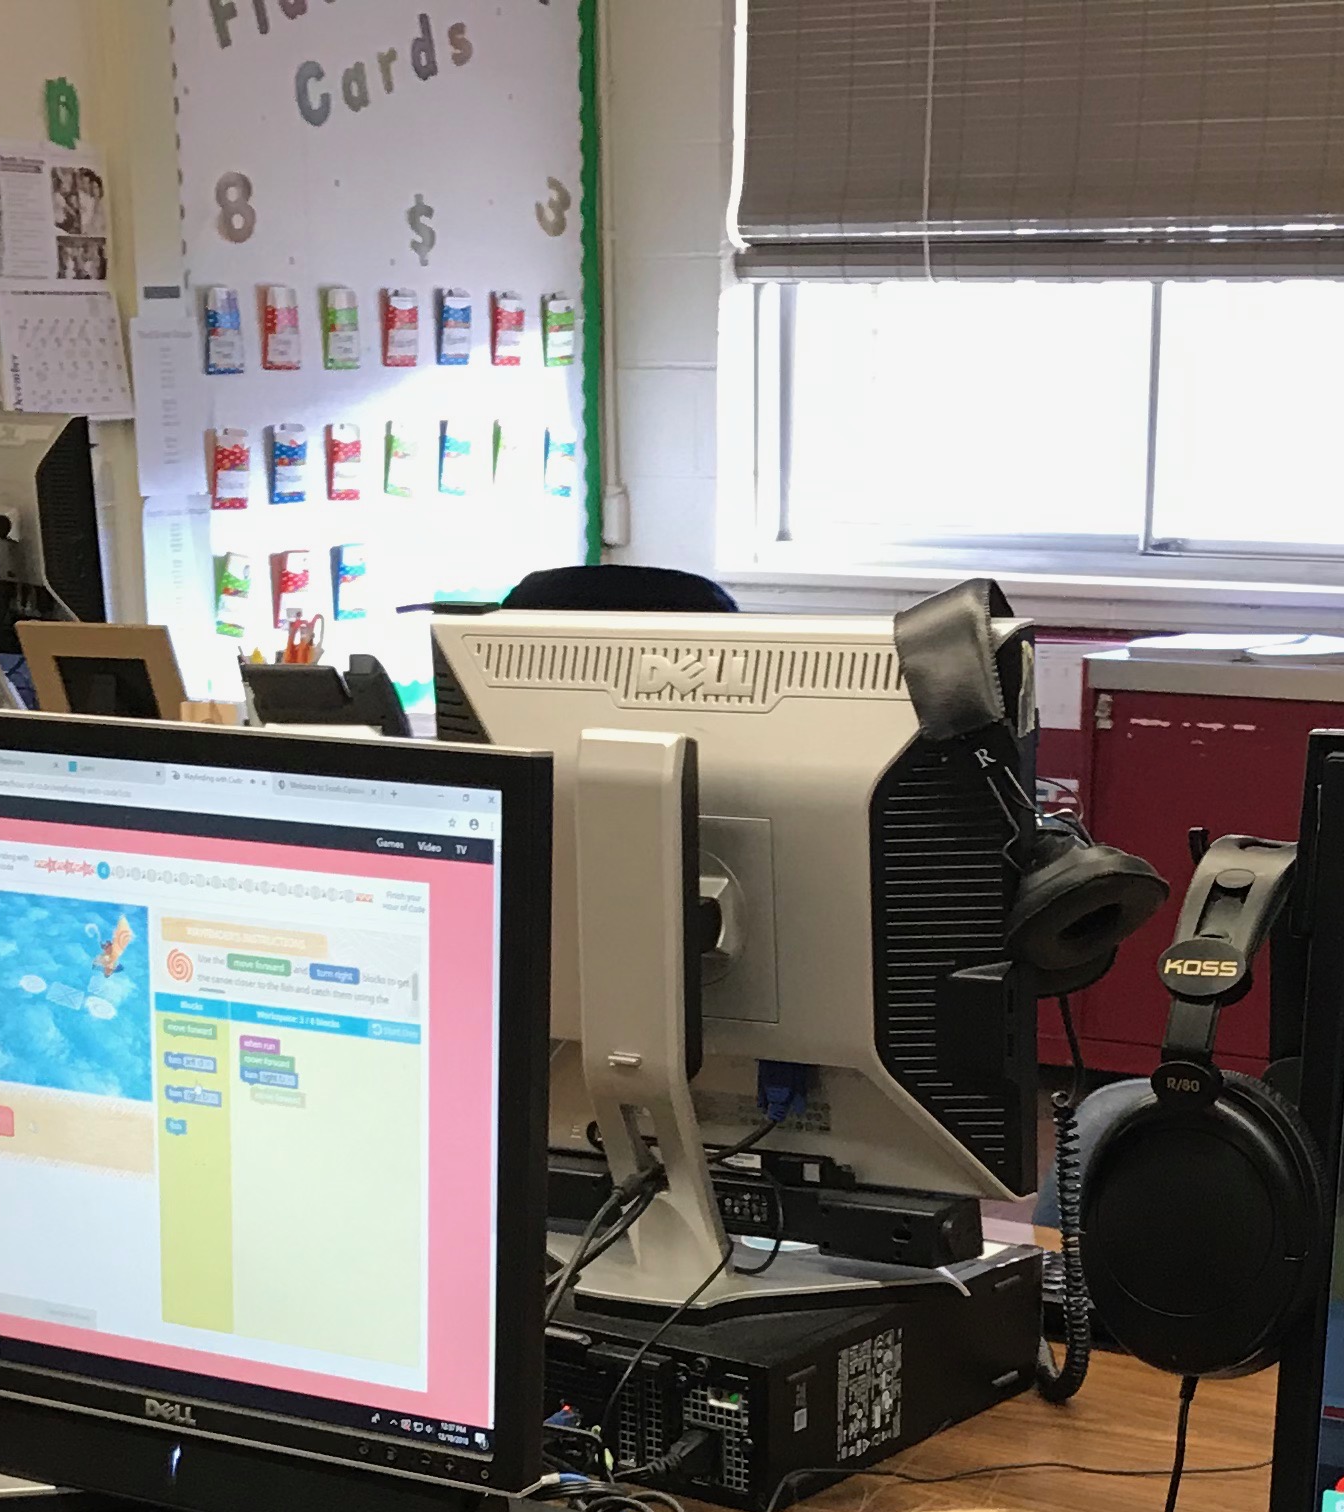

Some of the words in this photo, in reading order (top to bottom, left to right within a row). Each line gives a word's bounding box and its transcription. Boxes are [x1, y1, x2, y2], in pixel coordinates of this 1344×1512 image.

[295, 12, 474, 127] Cards
[215, 171, 256, 244] 8
[407, 193, 436, 267] $
[637, 653, 755, 697] DELL
[974, 747, 996, 768] R
[376, 837, 404, 849] Games
[417, 841, 442, 852] Video
[455, 844, 467, 855] TV
[1163, 958, 1239, 977] KOSS
[1166, 1076, 1200, 1093] R/80
[145, 1398, 197, 1427] DELL
